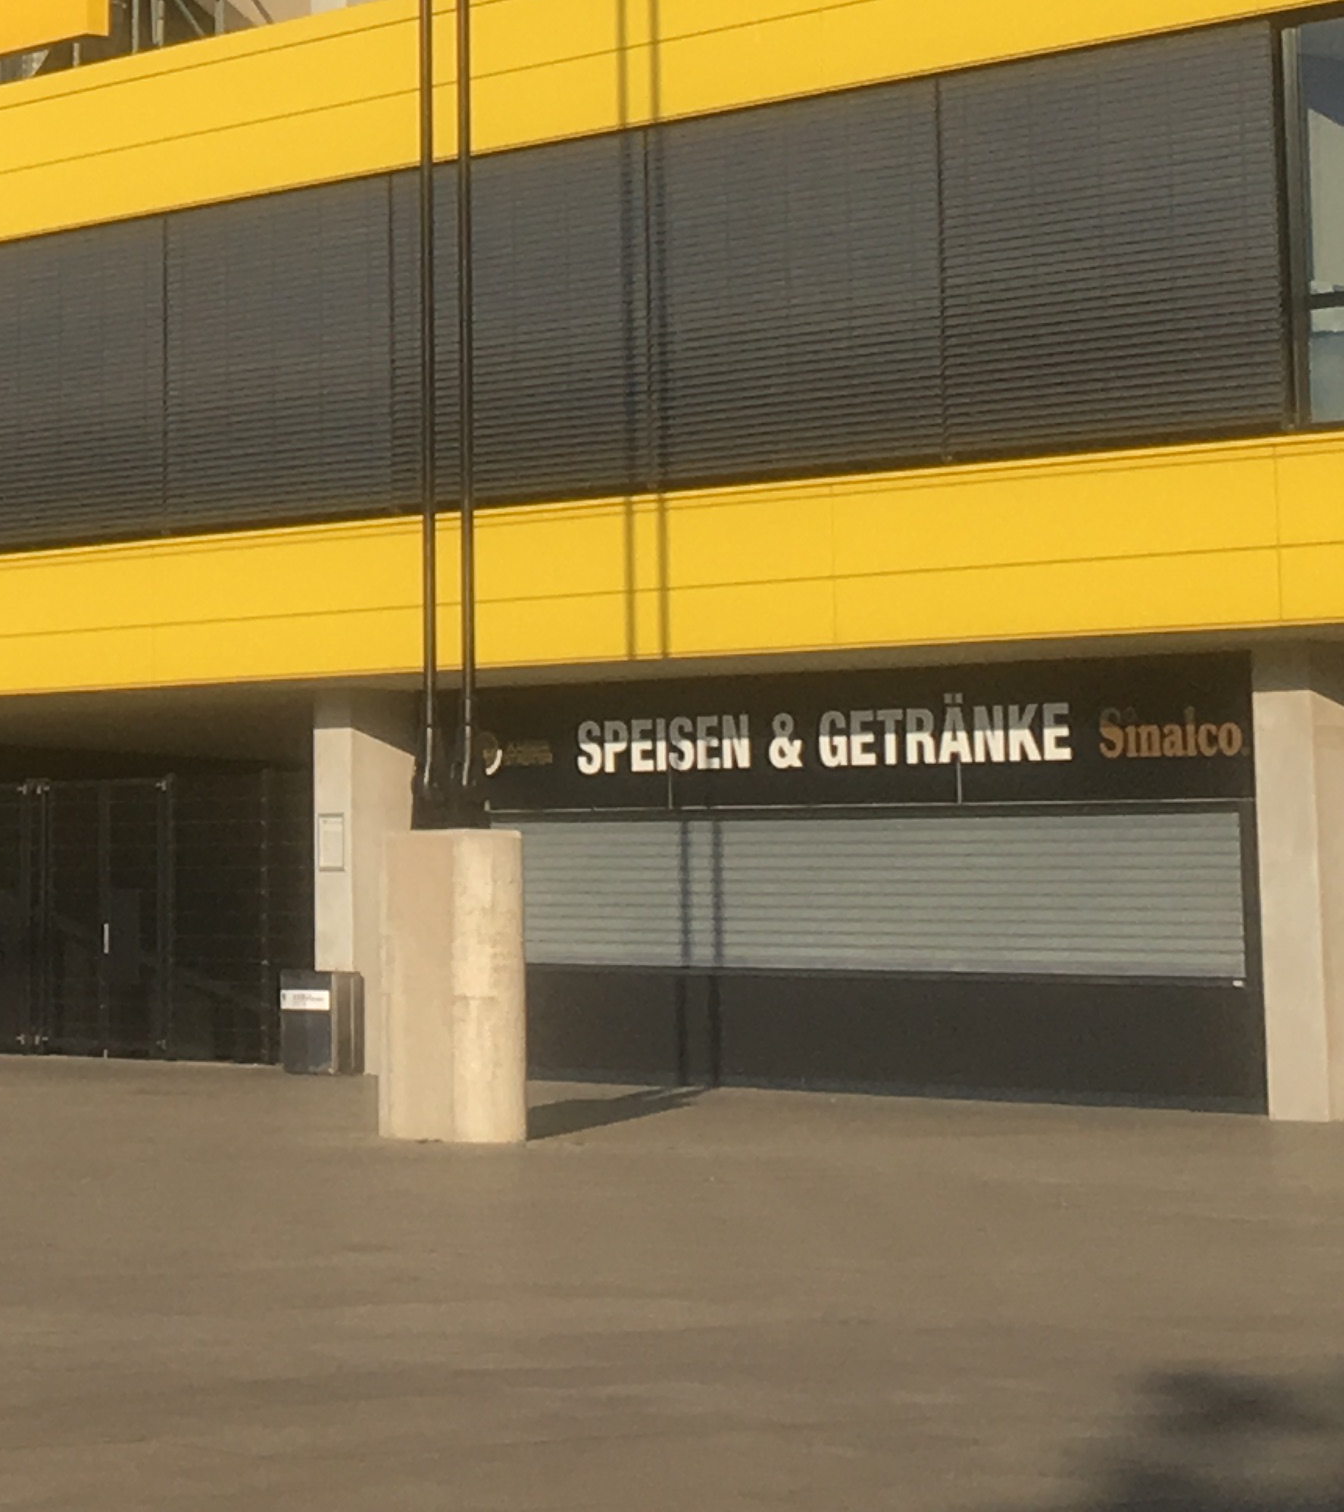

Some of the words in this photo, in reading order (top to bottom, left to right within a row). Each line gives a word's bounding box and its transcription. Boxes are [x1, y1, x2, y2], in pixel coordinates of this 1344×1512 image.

[577, 714, 751, 775] SPEISEN
[768, 713, 803, 769] &
[818, 693, 1073, 767] GETRÄNKE
[1099, 706, 1243, 758] Sinalco
